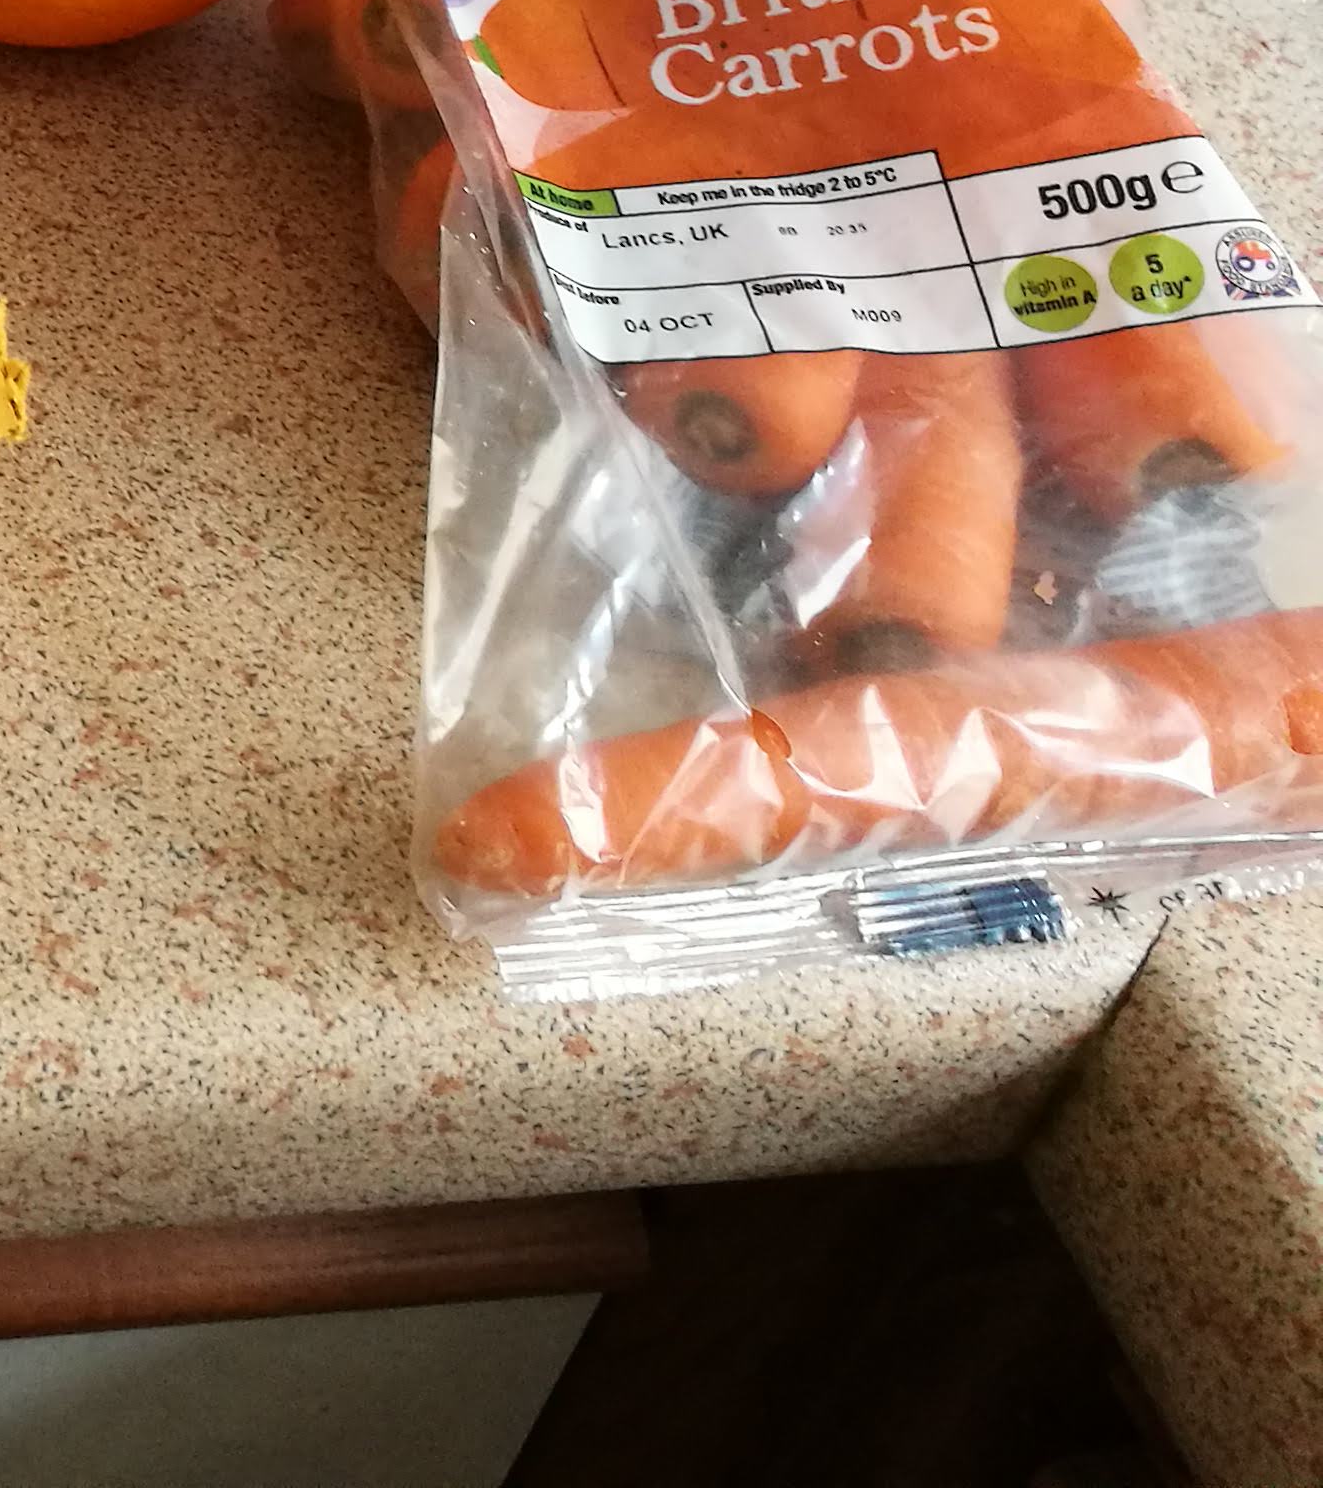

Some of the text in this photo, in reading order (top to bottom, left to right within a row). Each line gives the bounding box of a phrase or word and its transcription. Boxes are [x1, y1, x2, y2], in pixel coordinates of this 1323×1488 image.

[649, 6, 1001, 107] Carrots
[529, 182, 595, 211] At home
[656, 189, 699, 209] Keep
[702, 186, 729, 202] me
[731, 184, 747, 199] in
[750, 182, 776, 199] the
[778, 178, 826, 204] fridge
[828, 176, 841, 192] 2
[843, 172, 862, 188] to
[1038, 173, 1157, 220] 500g
[601, 230, 685, 250] Lancs,
[690, 223, 730, 243] UK
[1145, 253, 1164, 274] 5
[752, 279, 824, 297] Supplied
[1019, 275, 1077, 298] High in
[1131, 285, 1147, 302] a
[1011, 290, 1098, 317] vitamin A
[623, 311, 715, 334] 04 OCT
[852, 308, 903, 325] M009
